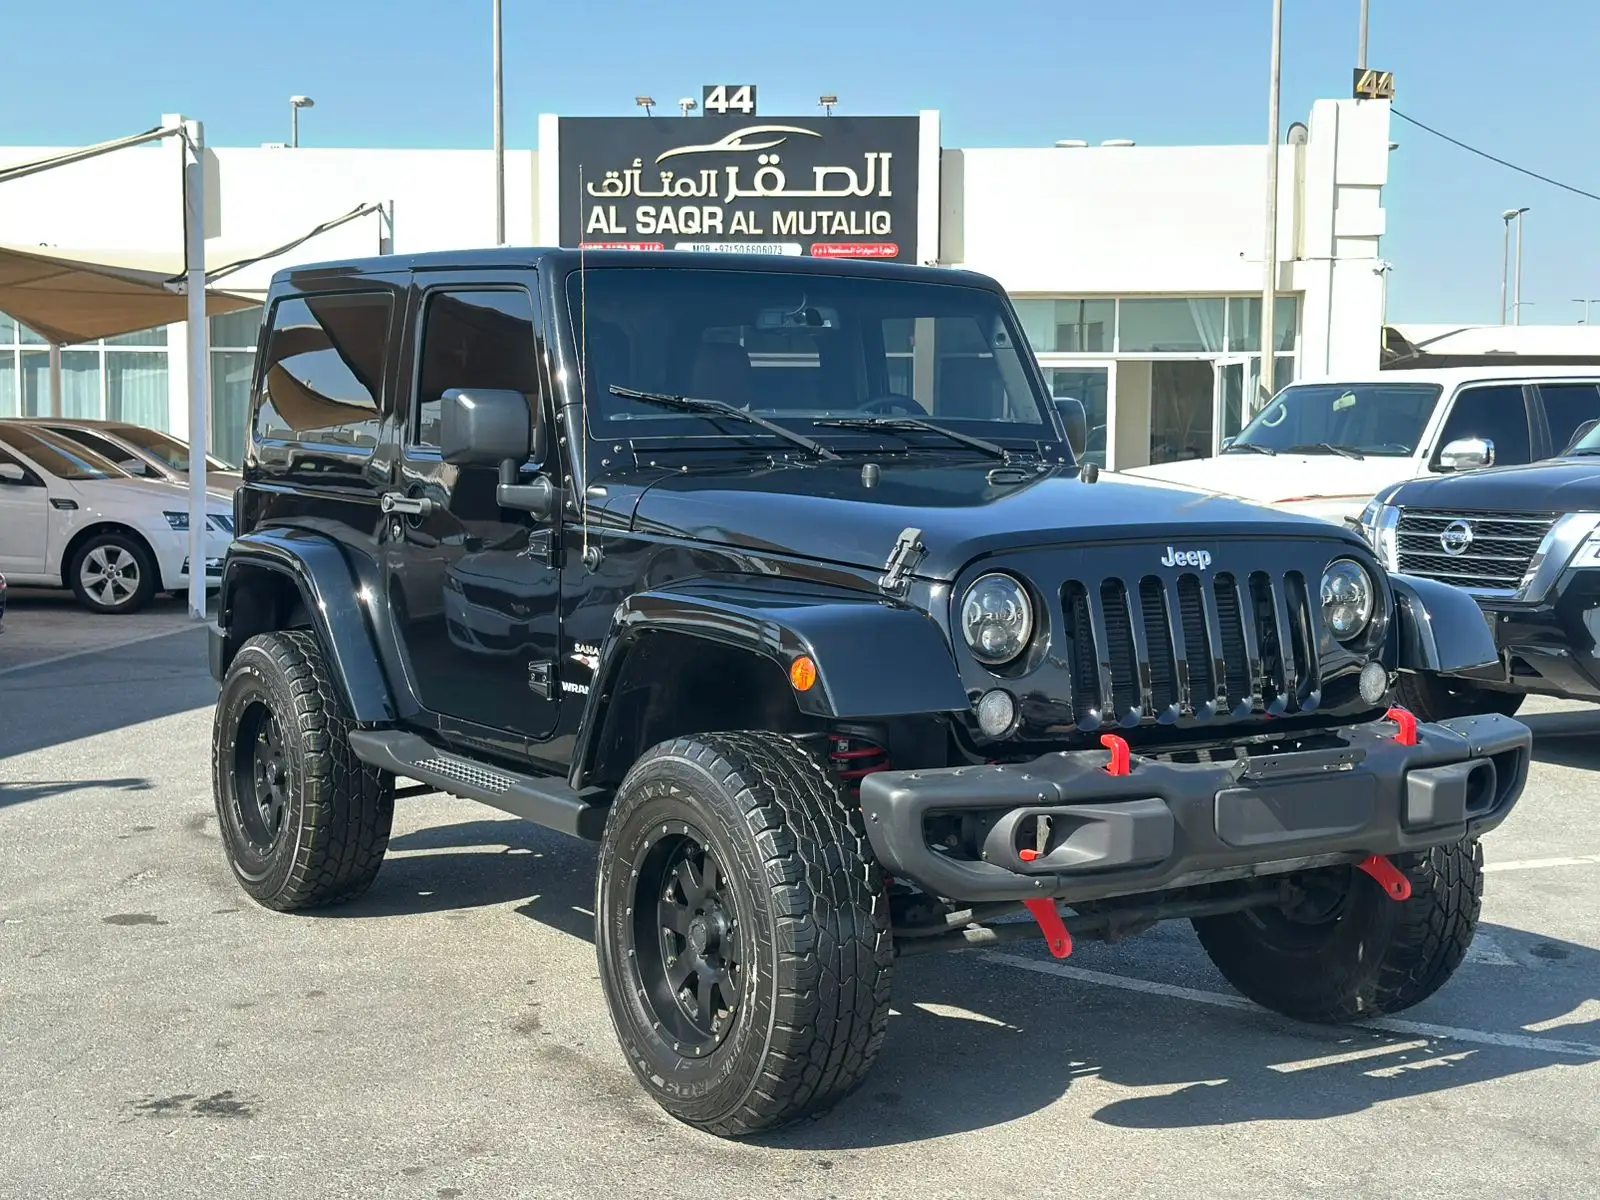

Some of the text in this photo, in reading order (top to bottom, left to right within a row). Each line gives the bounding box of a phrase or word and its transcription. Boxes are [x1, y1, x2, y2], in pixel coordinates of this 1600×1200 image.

[1356, 70, 1395, 99] 44
[705, 85, 754, 113] 44
[587, 152, 893, 204] الصقر المتألق
[586, 205, 891, 235] AL SAQR AL MUTALIQ
[1161, 546, 1211, 570] Jeep
[574, 643, 601, 656] SAHA
